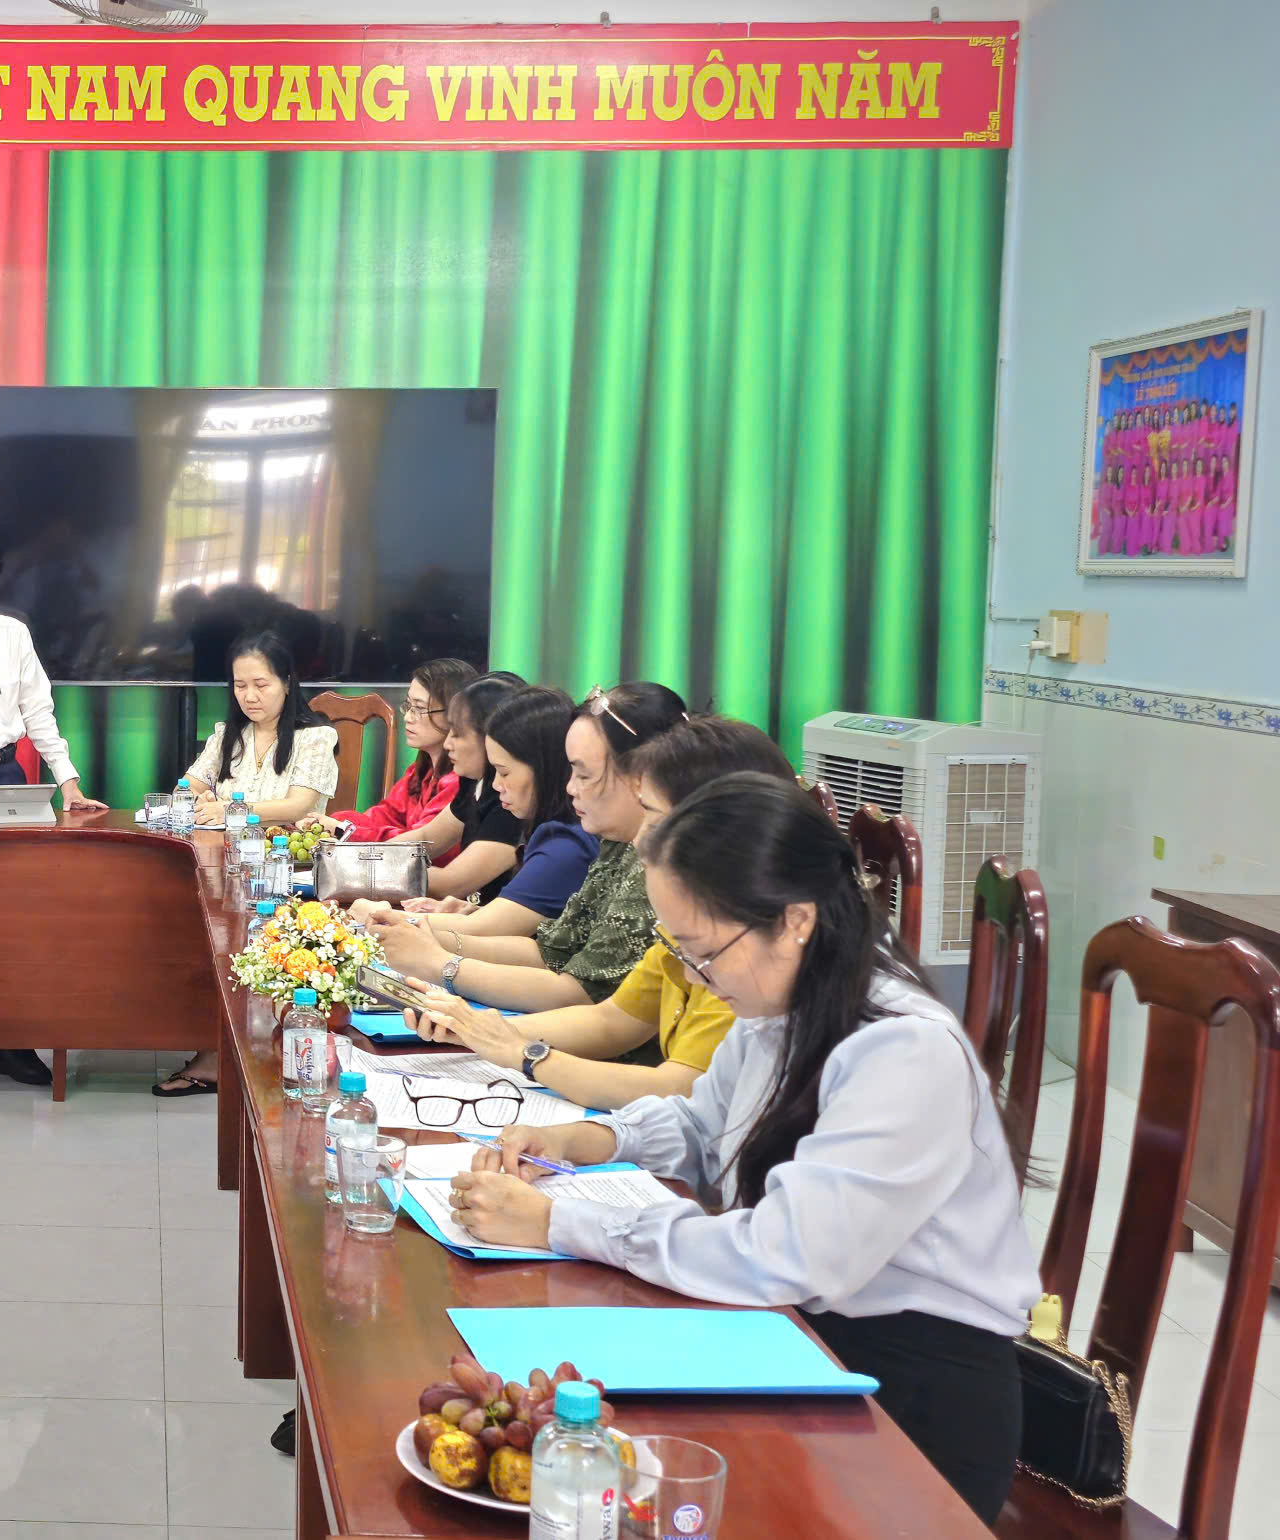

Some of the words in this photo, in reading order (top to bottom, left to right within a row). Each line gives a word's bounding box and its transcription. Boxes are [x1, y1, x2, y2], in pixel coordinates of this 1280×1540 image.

[26, 65, 167, 122] NAM
[183, 64, 410, 127] QUANG
[426, 64, 578, 122] VINH
[593, 48, 782, 122] MUÔN
[795, 48, 942, 120] NĂM
